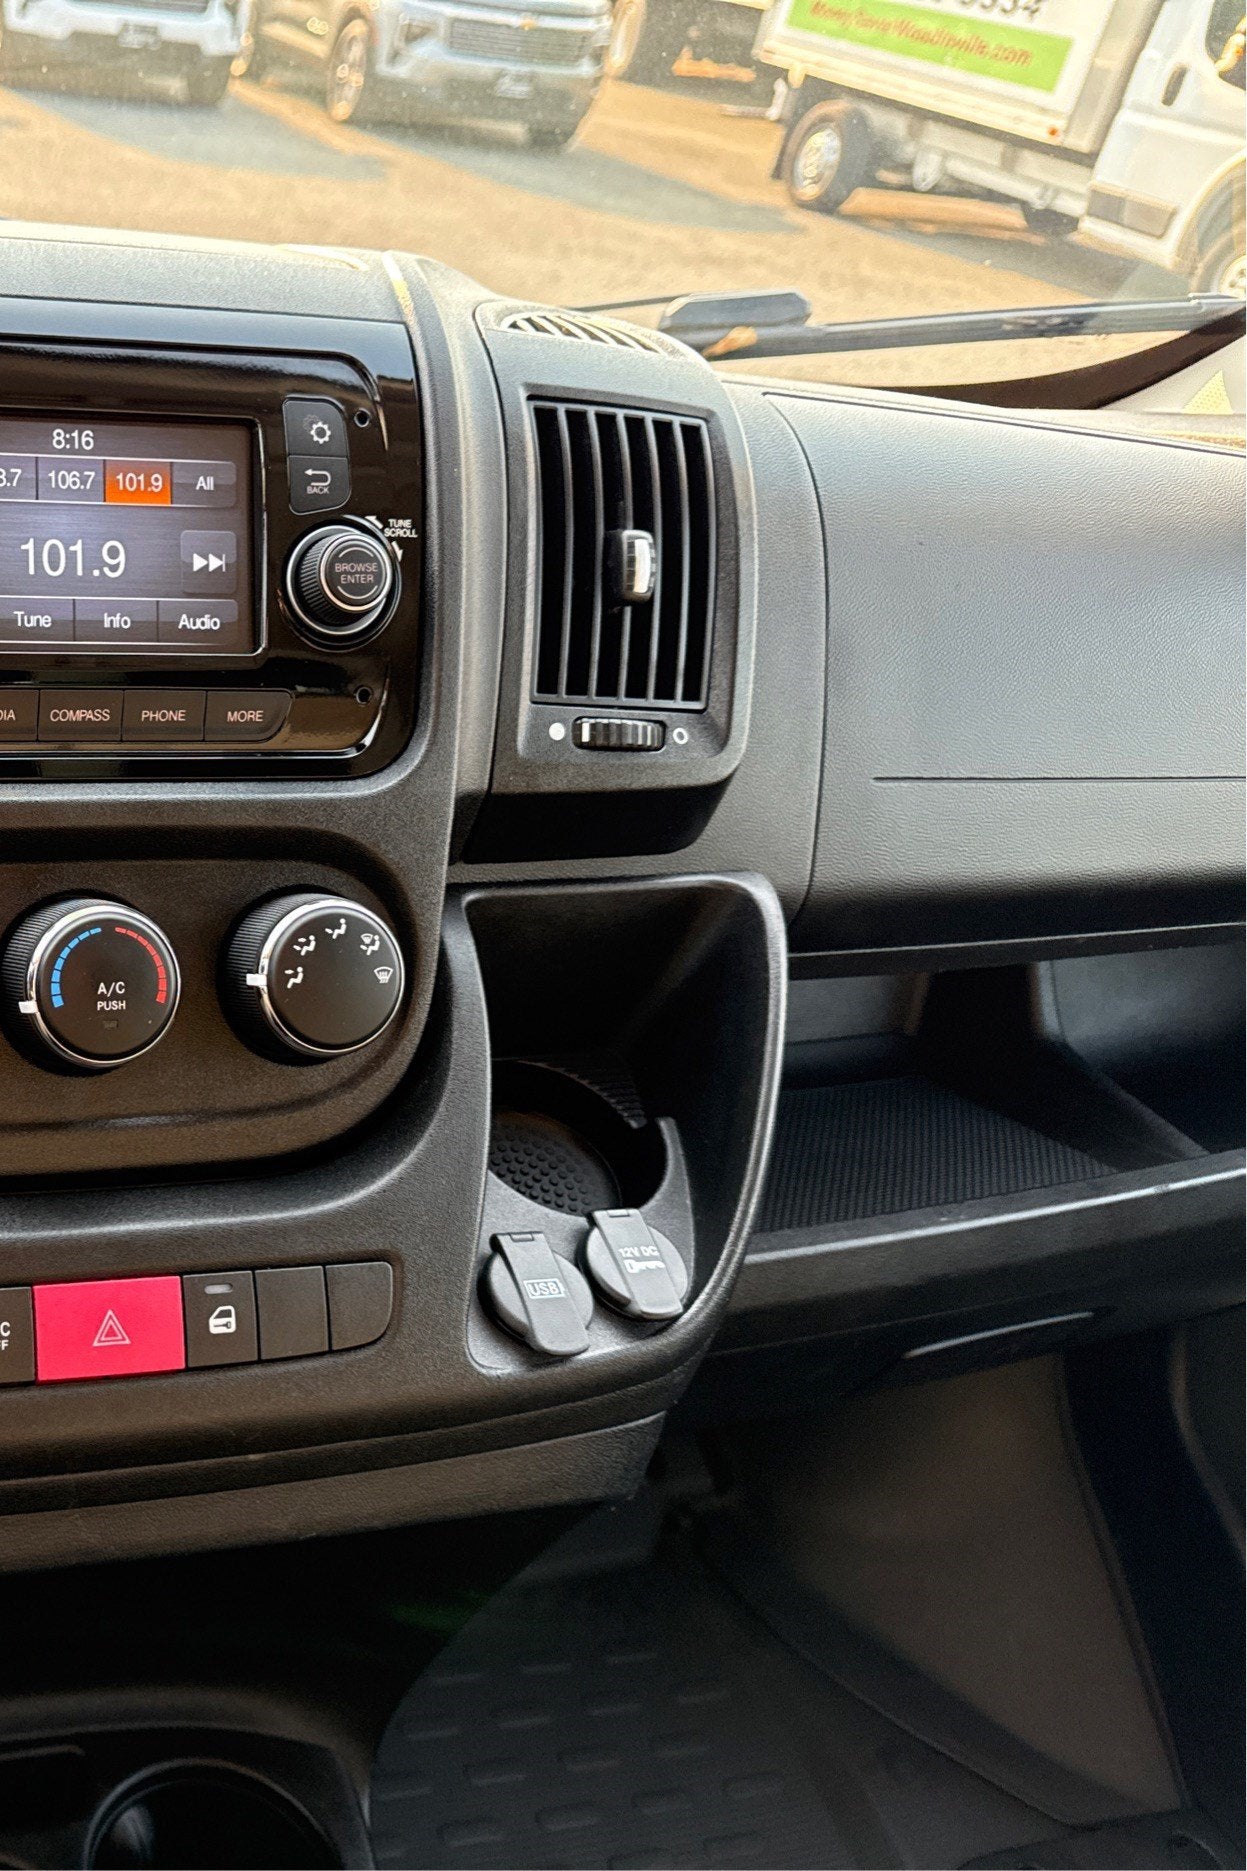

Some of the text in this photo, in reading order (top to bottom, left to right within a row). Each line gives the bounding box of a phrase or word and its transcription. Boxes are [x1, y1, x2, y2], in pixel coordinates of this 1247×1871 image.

[53, 429, 94, 450] 8:16
[48, 471, 95, 489] 106.7
[116, 473, 162, 492] 101.9
[196, 476, 213, 490] All
[307, 484, 329, 494] BACK
[388, 519, 411, 528] TUNE
[384, 528, 418, 539] SCROLL
[21, 538, 125, 577] 101.9
[334, 562, 379, 573] BROWSE
[341, 574, 373, 583] ENTER
[13, 611, 51, 627] Tune
[104, 613, 130, 628] Info
[178, 614, 220, 630] Audio
[50, 709, 110, 721] COMPASS
[142, 710, 185, 721] PHONE
[228, 711, 263, 722] MORE
[98, 982, 125, 996] A/C
[97, 1001, 125, 1010] PUSH
[618, 1245, 660, 1258] 12V DC
[528, 1282, 560, 1297] USB
